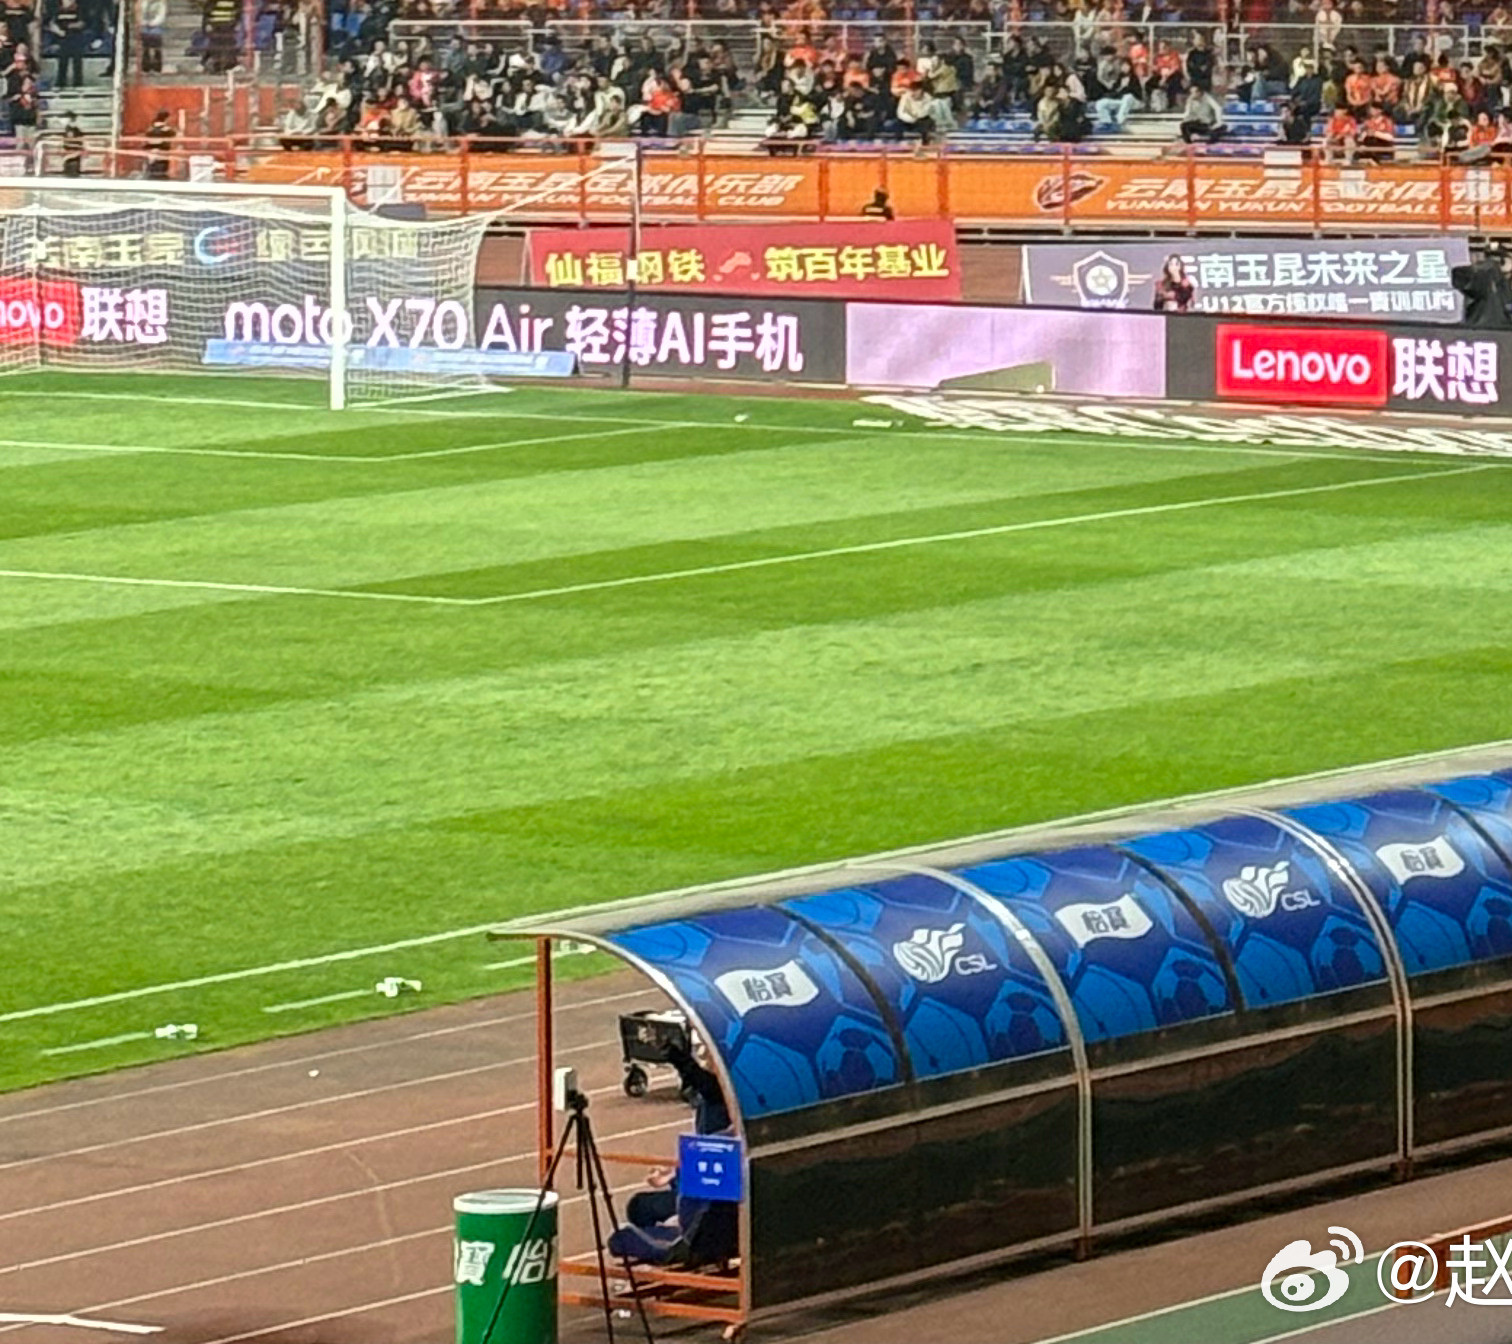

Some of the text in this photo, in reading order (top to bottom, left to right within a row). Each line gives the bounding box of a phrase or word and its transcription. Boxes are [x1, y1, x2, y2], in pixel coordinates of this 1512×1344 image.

[718, 195, 785, 206] CLUB
[1217, 200, 1306, 213] YUKUN
[765, 244, 949, 282] 筑百年基业
[80, 286, 168, 345] 联想
[224, 294, 353, 346] moto
[367, 296, 468, 351] X70
[481, 303, 553, 355] Air
[566, 304, 803, 373] 轻薄AI手机
[1232, 338, 1499, 404] Lenovo 联想
[1281, 890, 1321, 912] CSL
[955, 953, 998, 976] CSL
